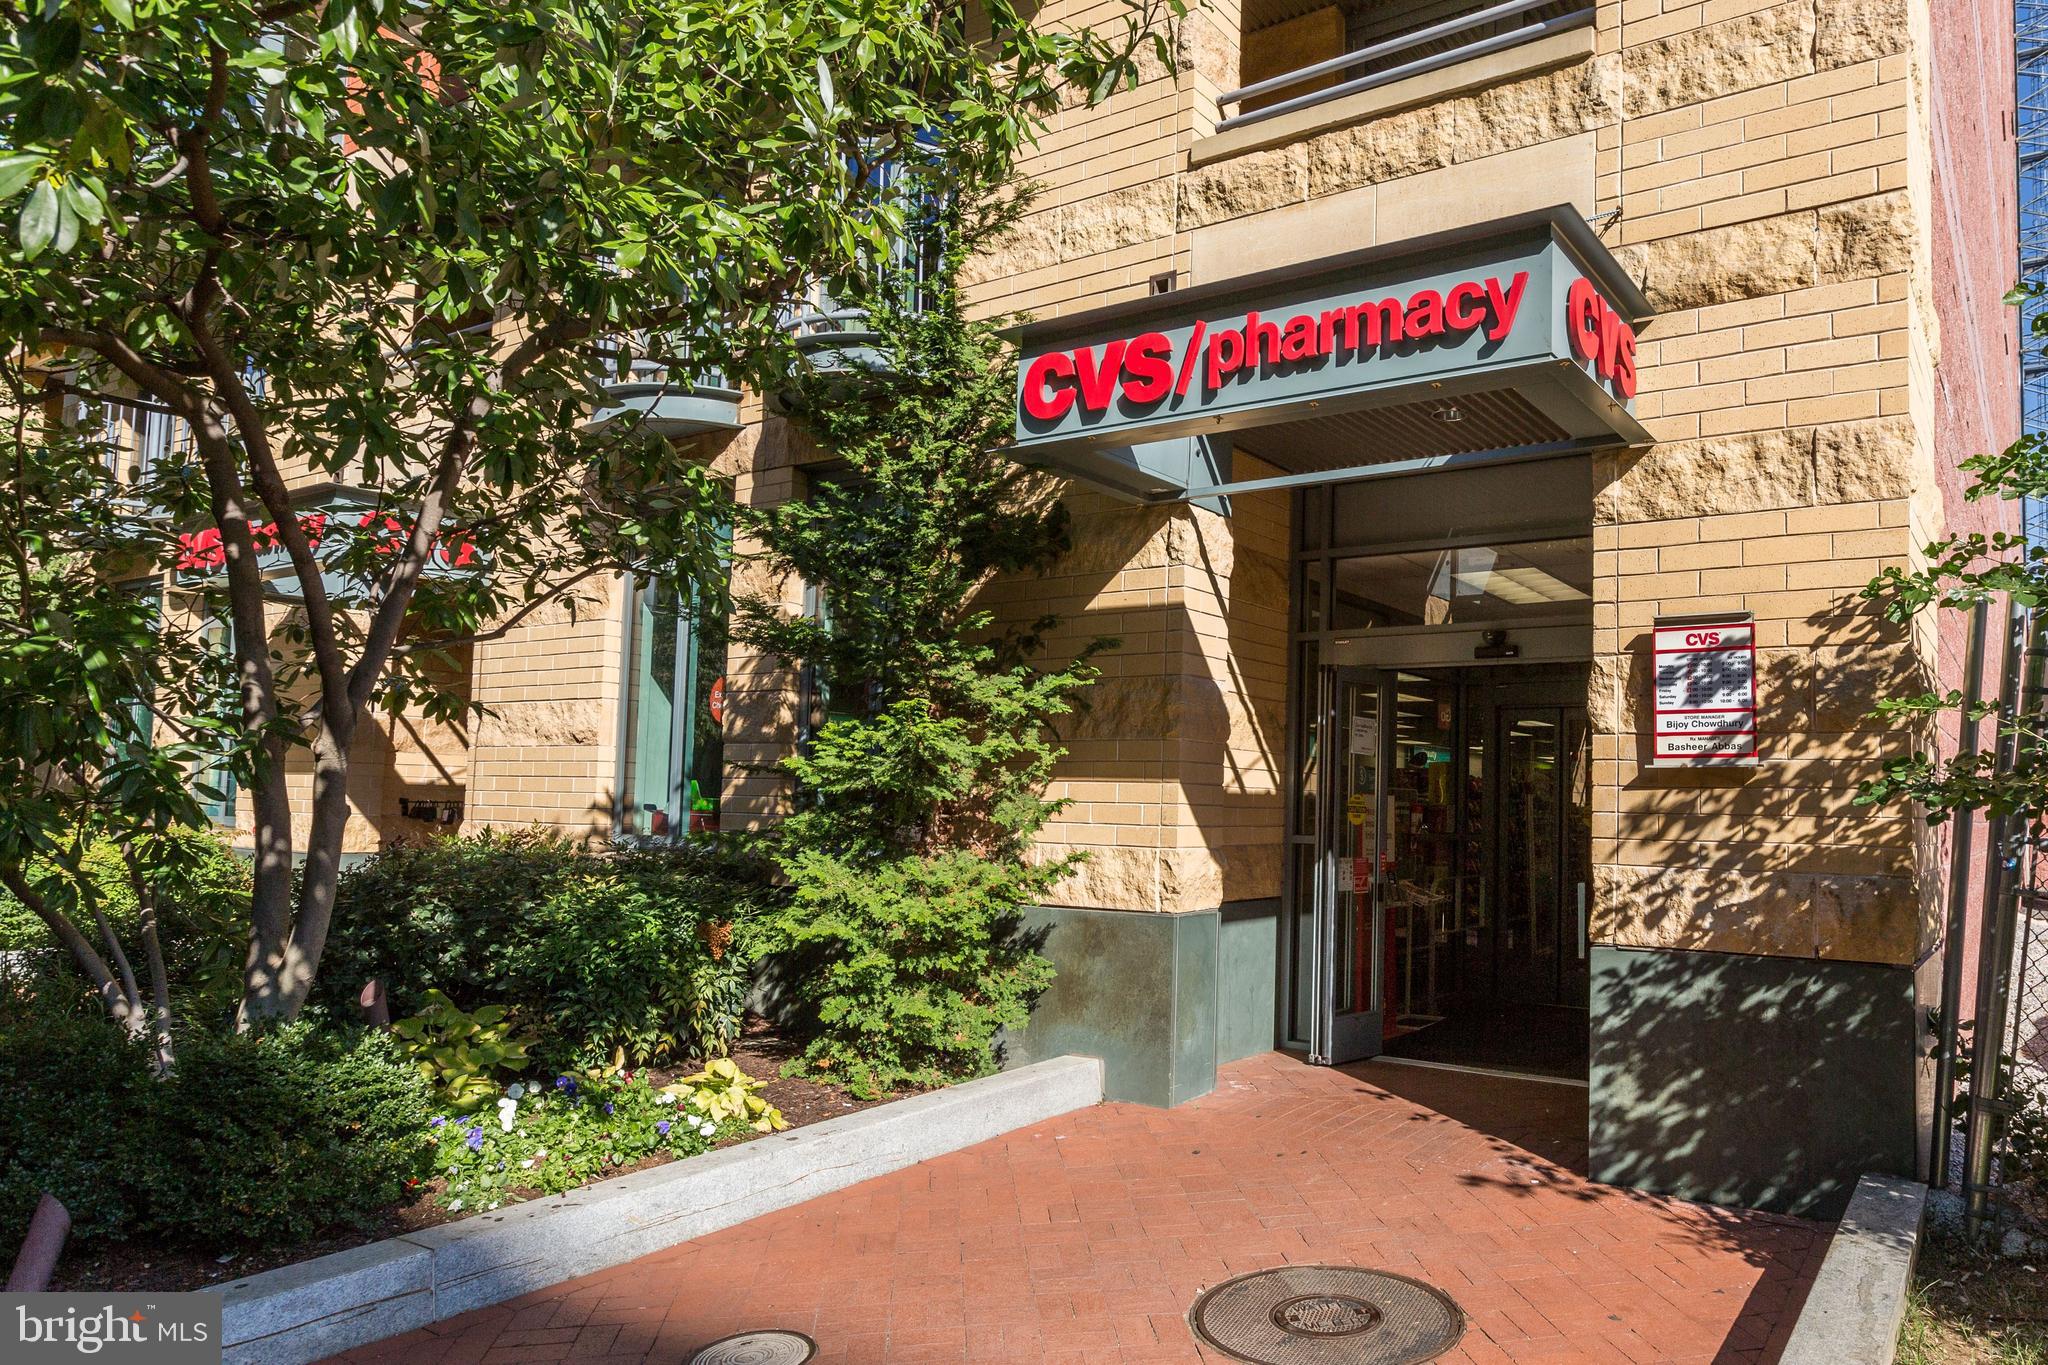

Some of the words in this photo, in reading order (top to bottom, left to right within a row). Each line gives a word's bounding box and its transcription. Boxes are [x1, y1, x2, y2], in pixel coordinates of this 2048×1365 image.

[1024, 271, 1529, 420] CVS/pharmacy
[1569, 277, 1636, 400] CVS
[1686, 632, 1720, 646] CVS
[1666, 720, 1688, 730] Bijoy
[1691, 719, 1744, 729] Chowdhury
[1667, 743, 1708, 751] Basheer
[1711, 742, 1743, 750] Abbas
